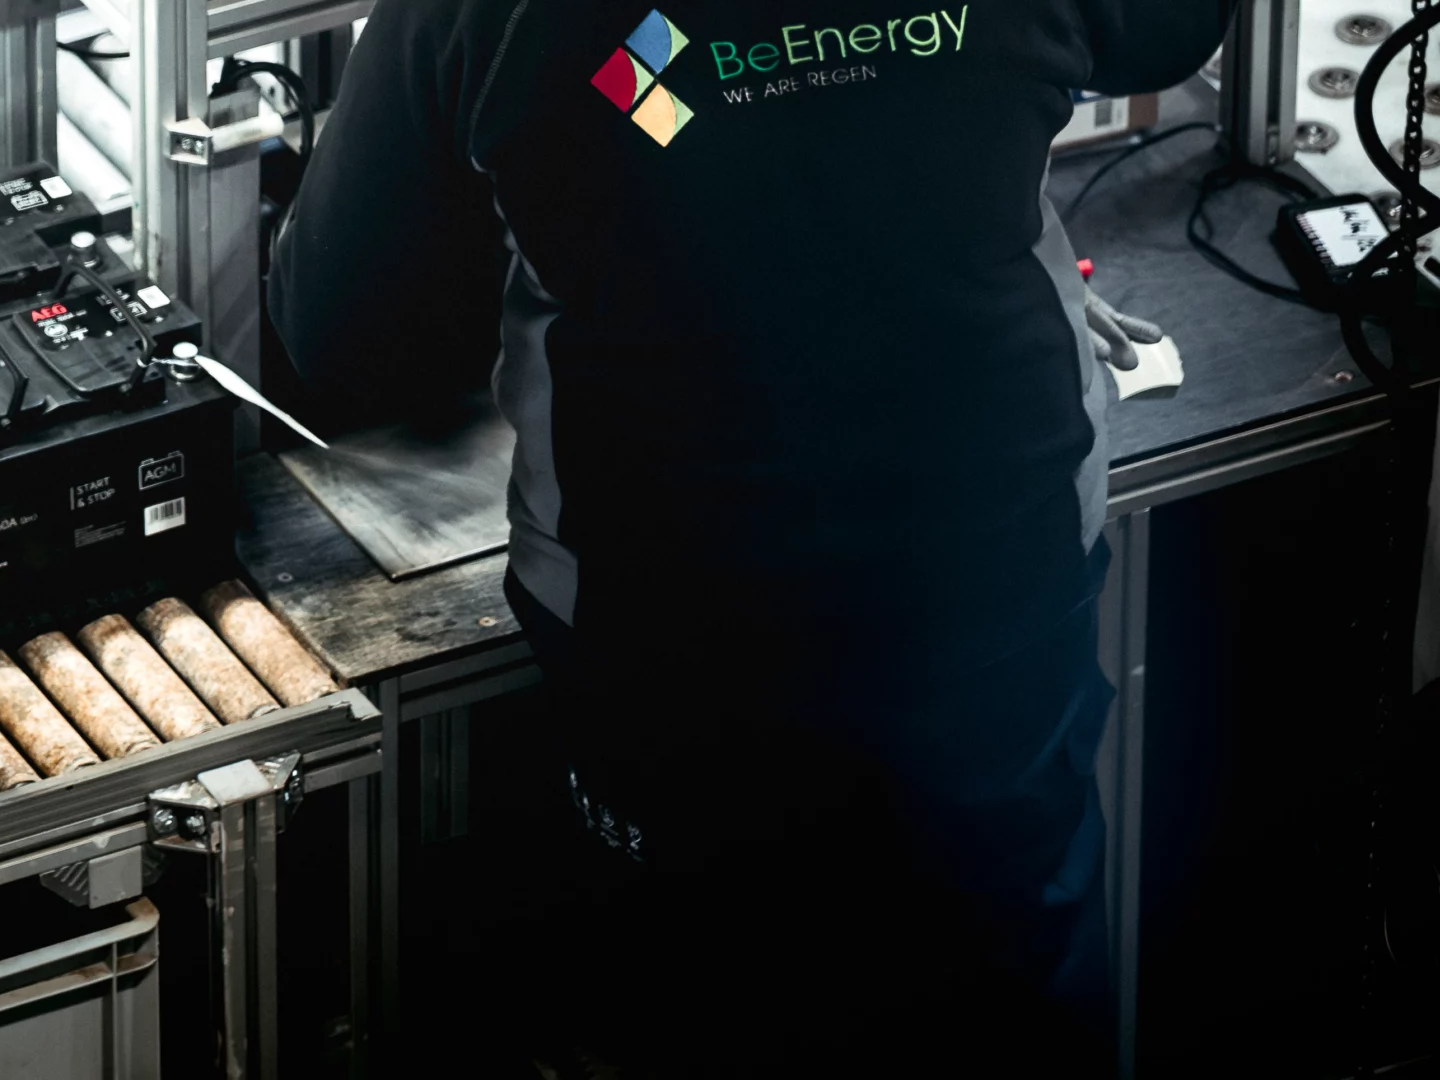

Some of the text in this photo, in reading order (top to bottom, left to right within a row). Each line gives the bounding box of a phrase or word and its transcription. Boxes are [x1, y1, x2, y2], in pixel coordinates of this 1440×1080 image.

[710, 4, 968, 80] BeEnergy
[723, 65, 877, 104] WE ARE REGEN
[31, 303, 68, 322] AEG
[144, 461, 176, 482] AGM
[76, 476, 110, 495] START
[76, 487, 115, 508] & STOP
